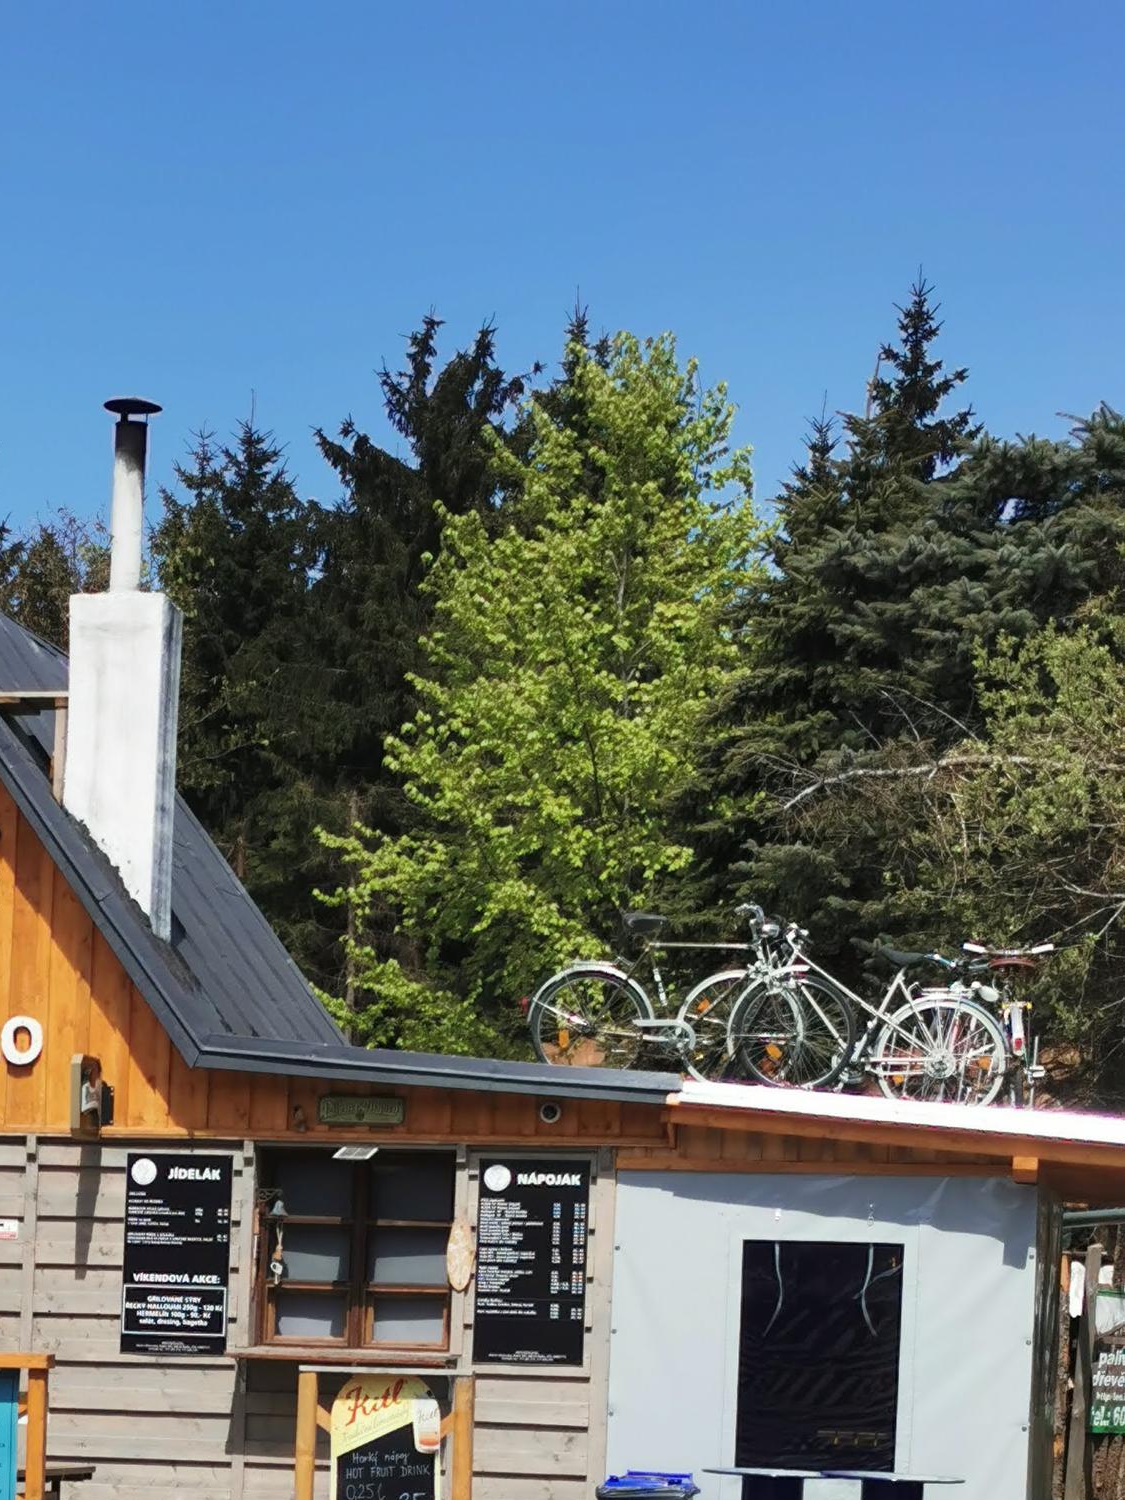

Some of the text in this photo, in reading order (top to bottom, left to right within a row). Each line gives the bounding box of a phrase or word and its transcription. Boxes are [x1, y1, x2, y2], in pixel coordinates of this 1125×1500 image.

[133, 1272, 221, 1285] VÍKENDOVÁ AKCE:
[346, 1465, 431, 1479] HOT FRUIT DRINK
